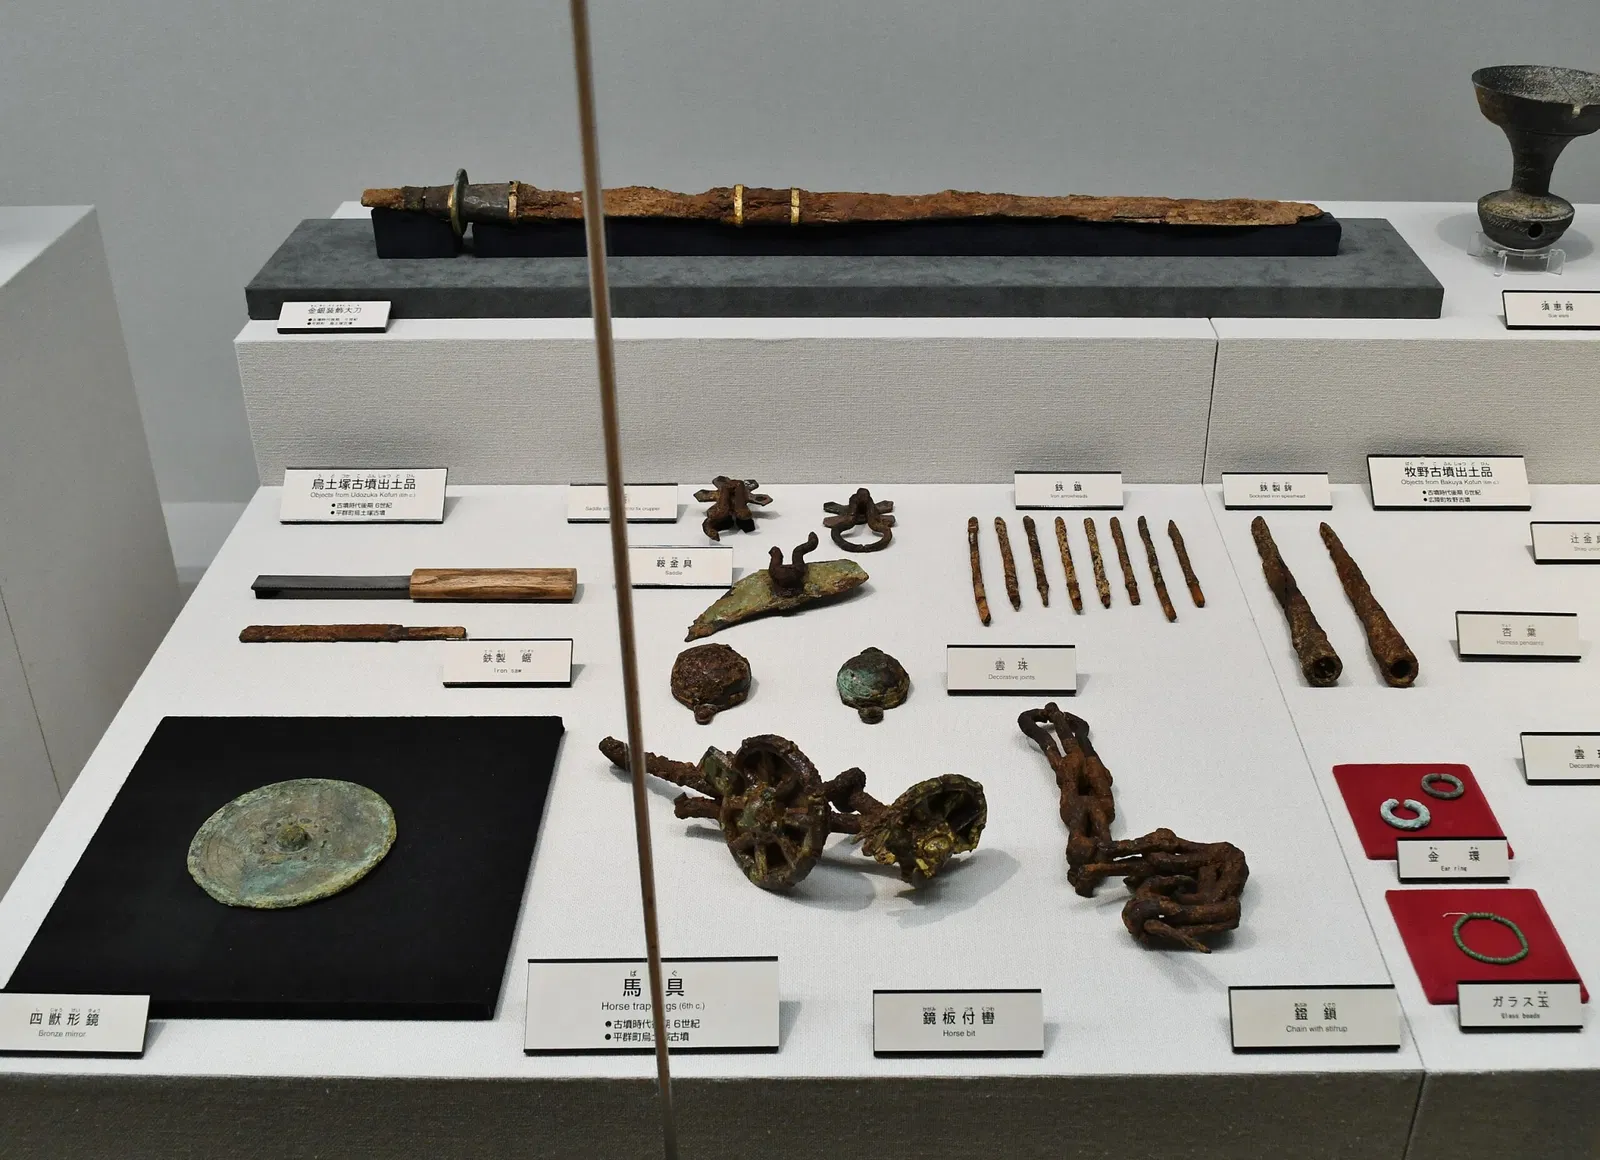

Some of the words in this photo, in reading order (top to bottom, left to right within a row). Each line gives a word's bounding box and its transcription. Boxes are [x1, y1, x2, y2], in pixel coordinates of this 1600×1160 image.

[1404, 466, 1493, 477] 牧野古墳出土品
[995, 660, 1028, 671] 雲珠
[1428, 851, 1480, 862] 金環
[623, 978, 684, 996] 馬具
[1493, 995, 1549, 1007] ガラス玉
[601, 1002, 630, 1010] Horse
[633, 1002, 677, 1012] trapgs
[679, 1002, 693, 1010] (6th
[695, 1002, 705, 1010] c.)
[923, 1011, 995, 1024] 鏡板付轡
[1295, 1007, 1337, 1020] 鐙鎖
[30, 1013, 100, 1026] 四獣形鏡
[674, 1020, 700, 1029] 6世紀
